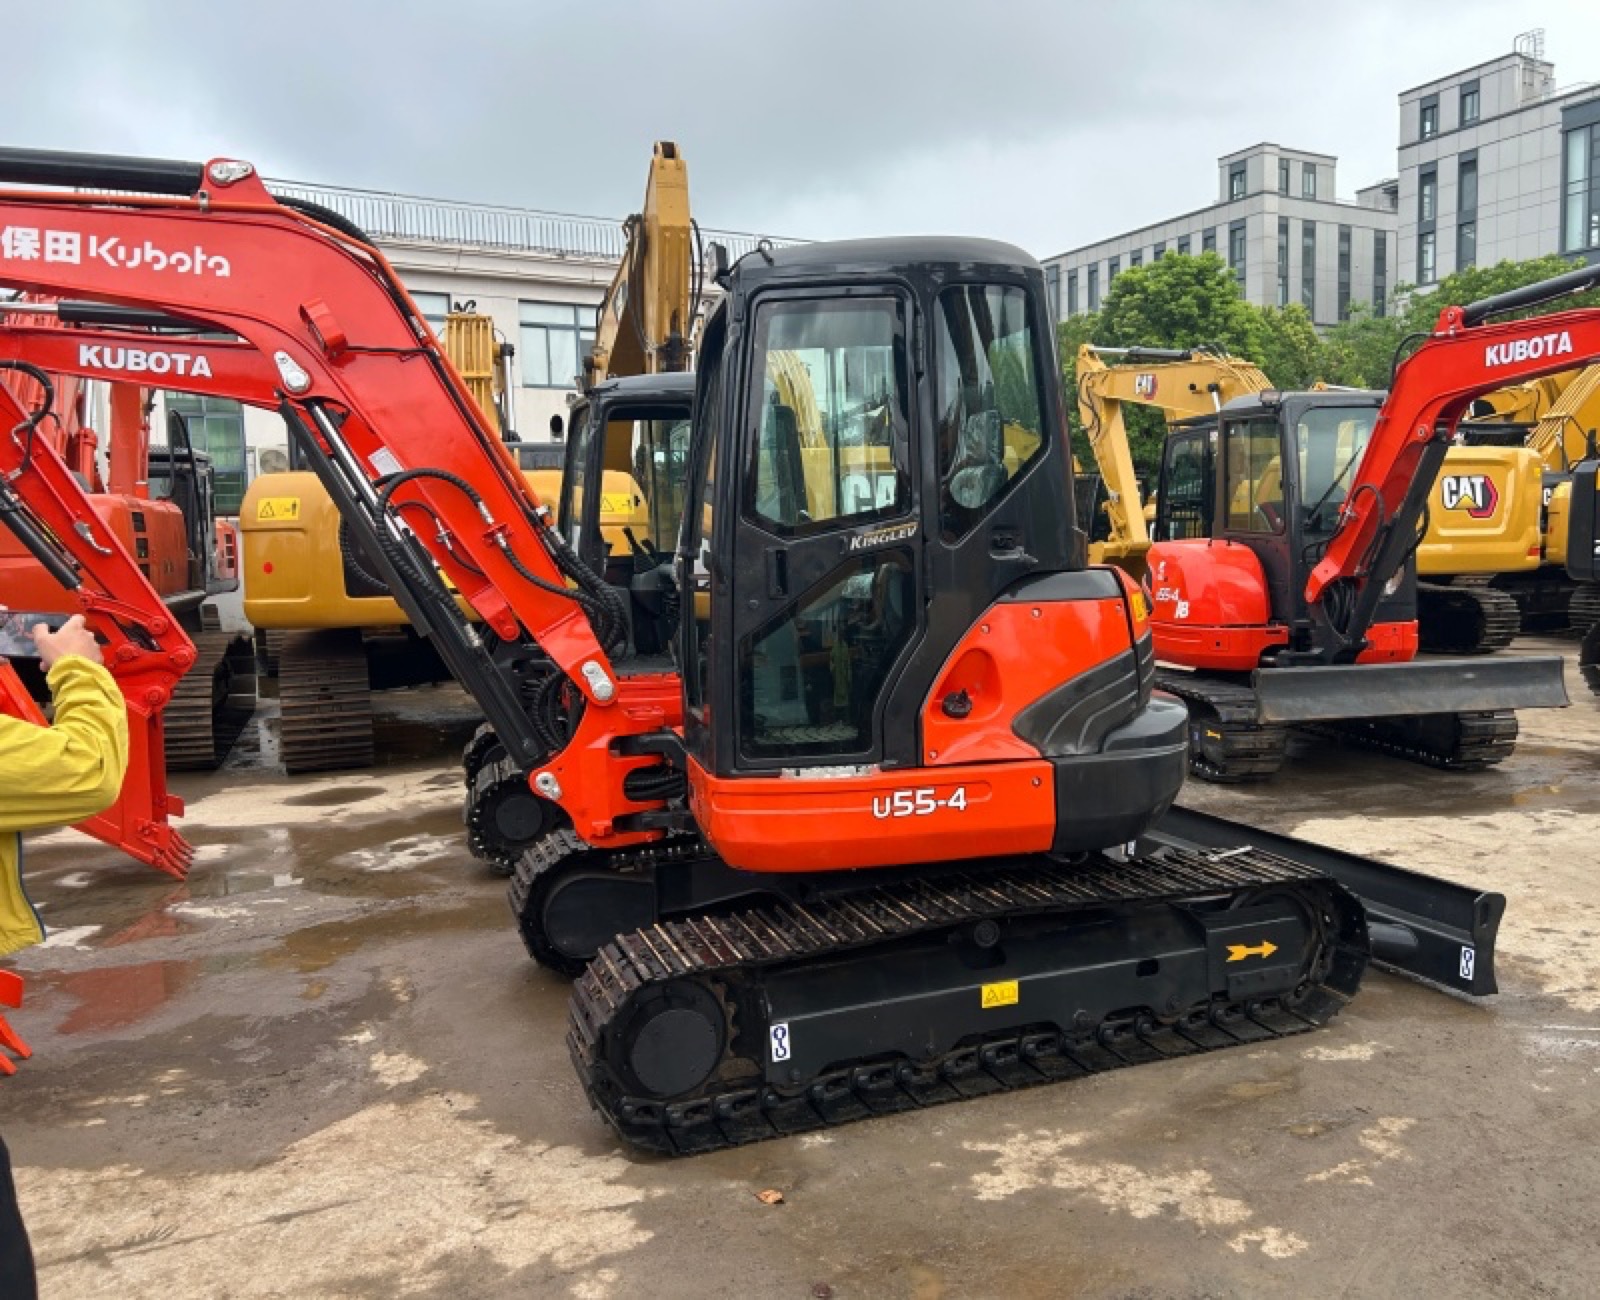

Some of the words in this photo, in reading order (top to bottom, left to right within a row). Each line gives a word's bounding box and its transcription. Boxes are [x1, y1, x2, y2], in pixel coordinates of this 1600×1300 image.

[1, 225, 80, 264] 保田
[88, 235, 231, 277] Kubota
[79, 343, 213, 378] KUBOTA
[1485, 331, 1573, 367] KUBOTA
[1135, 373, 1153, 395] CAT
[1442, 475, 1486, 509] CAT
